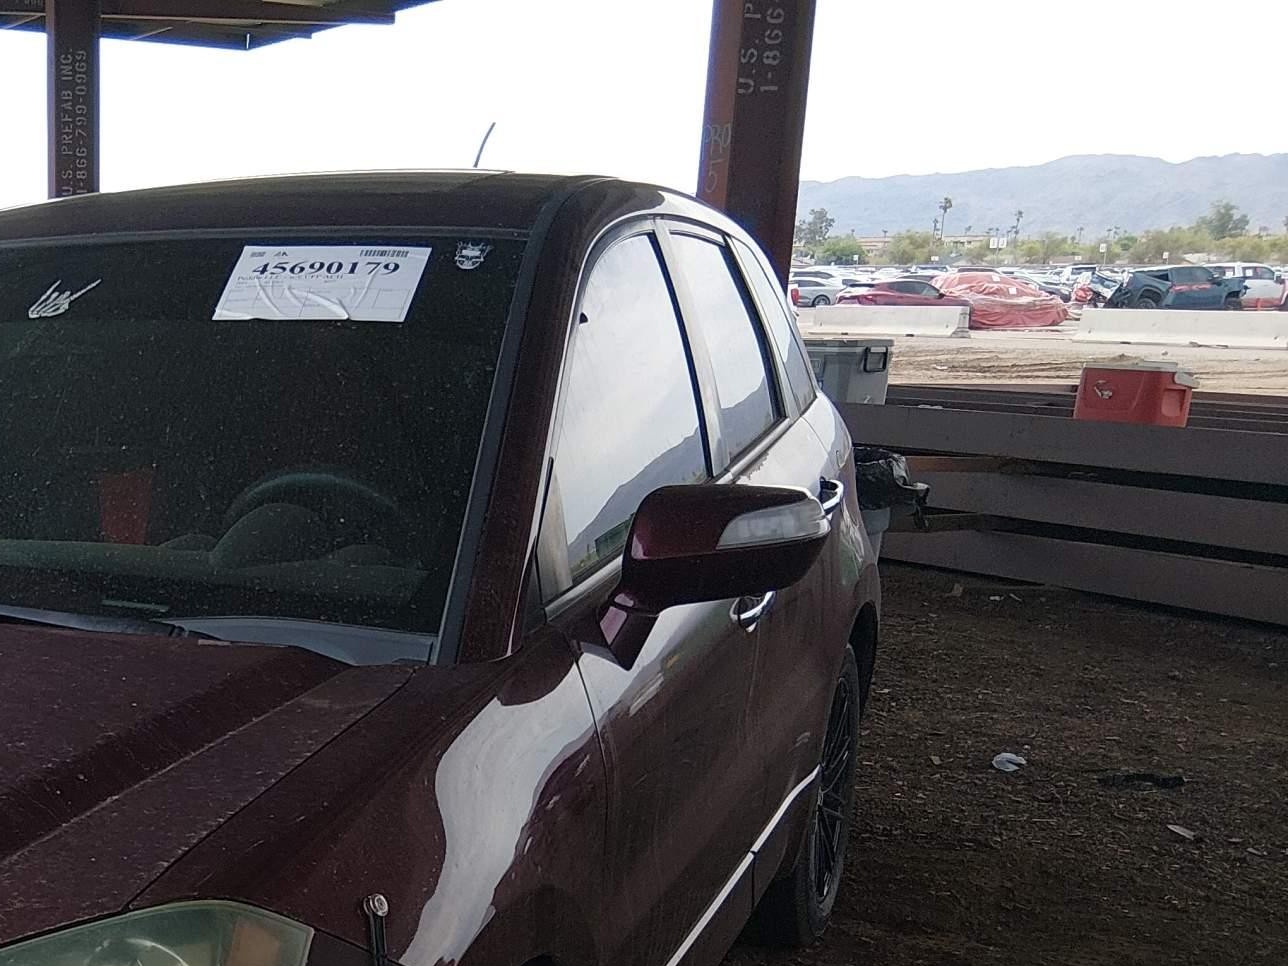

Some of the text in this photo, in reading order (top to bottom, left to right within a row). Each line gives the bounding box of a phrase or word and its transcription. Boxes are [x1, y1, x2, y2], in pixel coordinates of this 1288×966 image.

[60, 48, 74, 196] U.S. PREFAB INC.
[252, 260, 401, 276] 45690179
